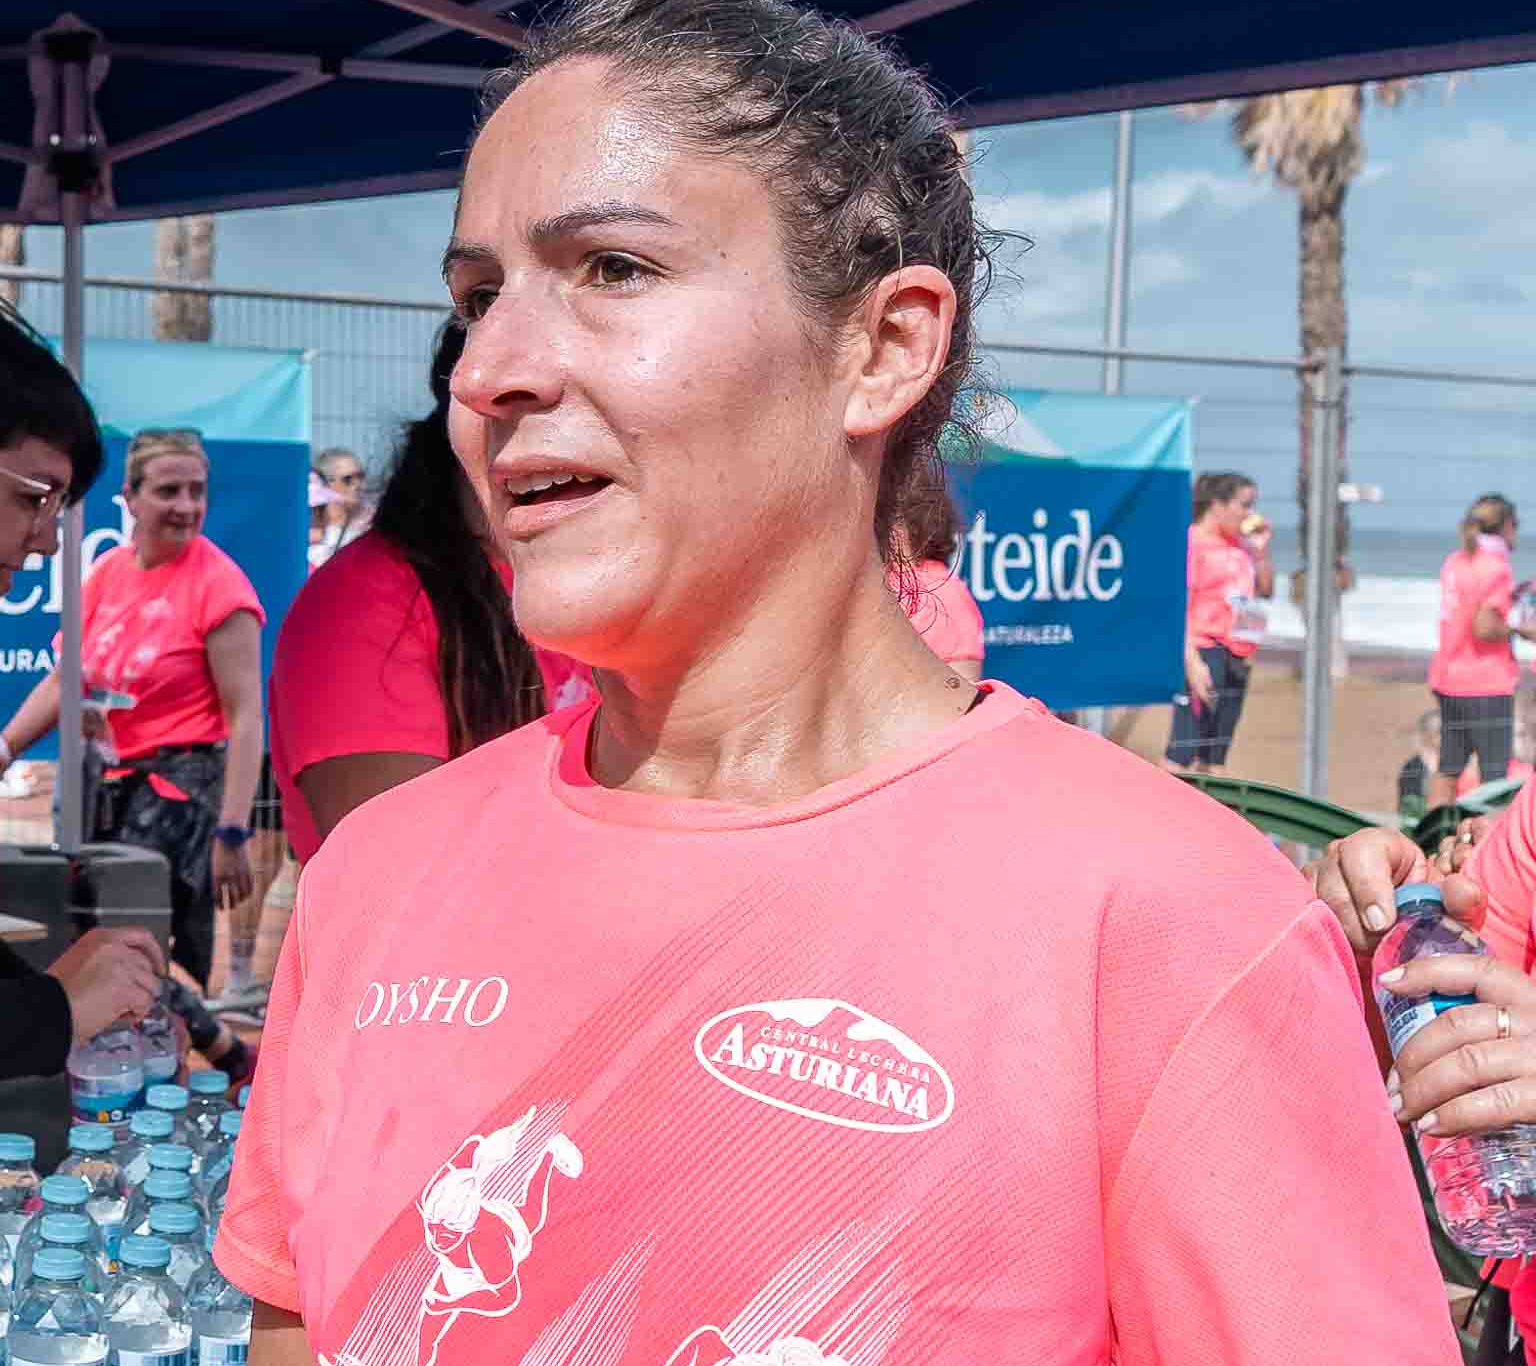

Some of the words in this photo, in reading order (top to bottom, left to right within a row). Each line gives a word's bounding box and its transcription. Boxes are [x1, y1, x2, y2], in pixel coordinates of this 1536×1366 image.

[953, 508, 1123, 601] teide
[354, 976, 508, 1029] OYSHO
[710, 1022, 929, 1121] ASTURIANA
[760, 1025, 841, 1055] CENTRAL
[847, 1047, 932, 1083] LECHERA
